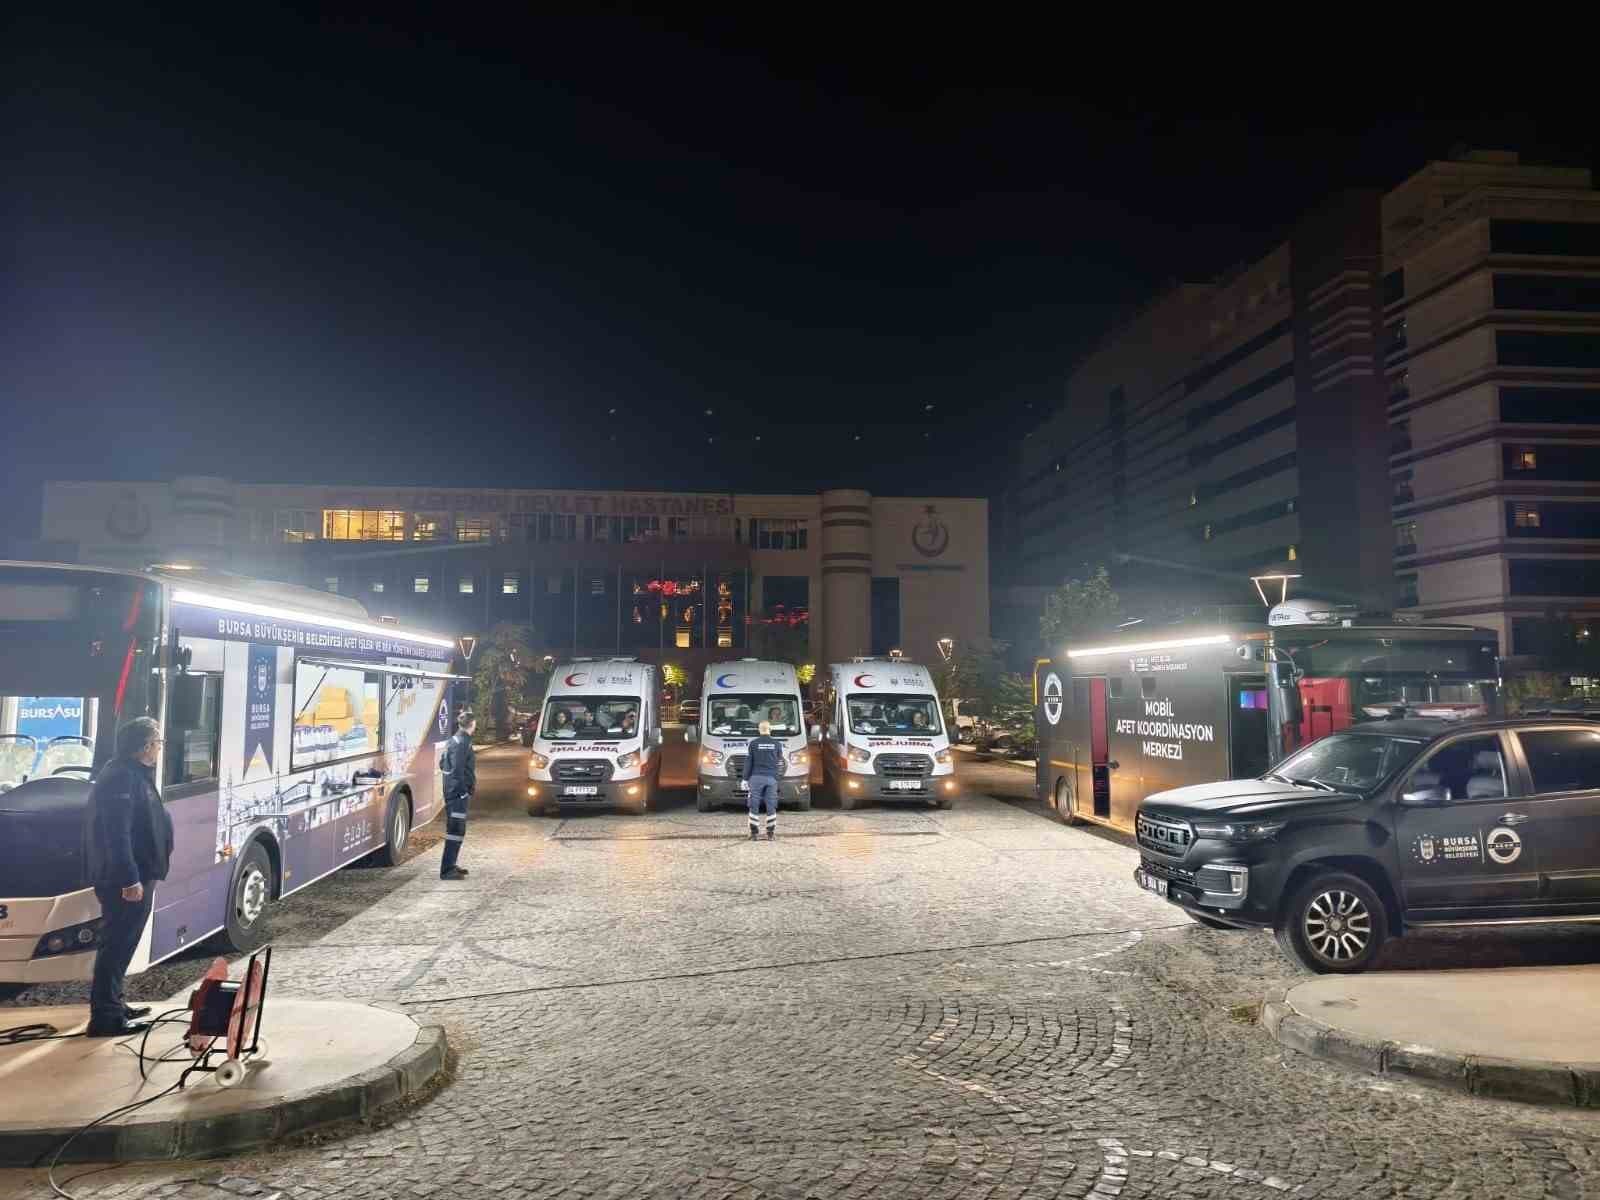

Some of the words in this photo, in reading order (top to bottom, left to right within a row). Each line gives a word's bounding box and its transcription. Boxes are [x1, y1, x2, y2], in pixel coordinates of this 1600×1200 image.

[218, 618, 251, 637] BURSA
[254, 621, 304, 644] BÜYÜKŞEHİR
[20, 703, 81, 719] BURSASU
[251, 703, 270, 713] BURSA
[1145, 697, 1175, 717] MOBİL
[1116, 719, 1137, 733] AFET
[1137, 718, 1214, 741] KOORDİNASYON
[1142, 741, 1182, 760] MERKEZİ
[1443, 836, 1478, 846] BURSA
